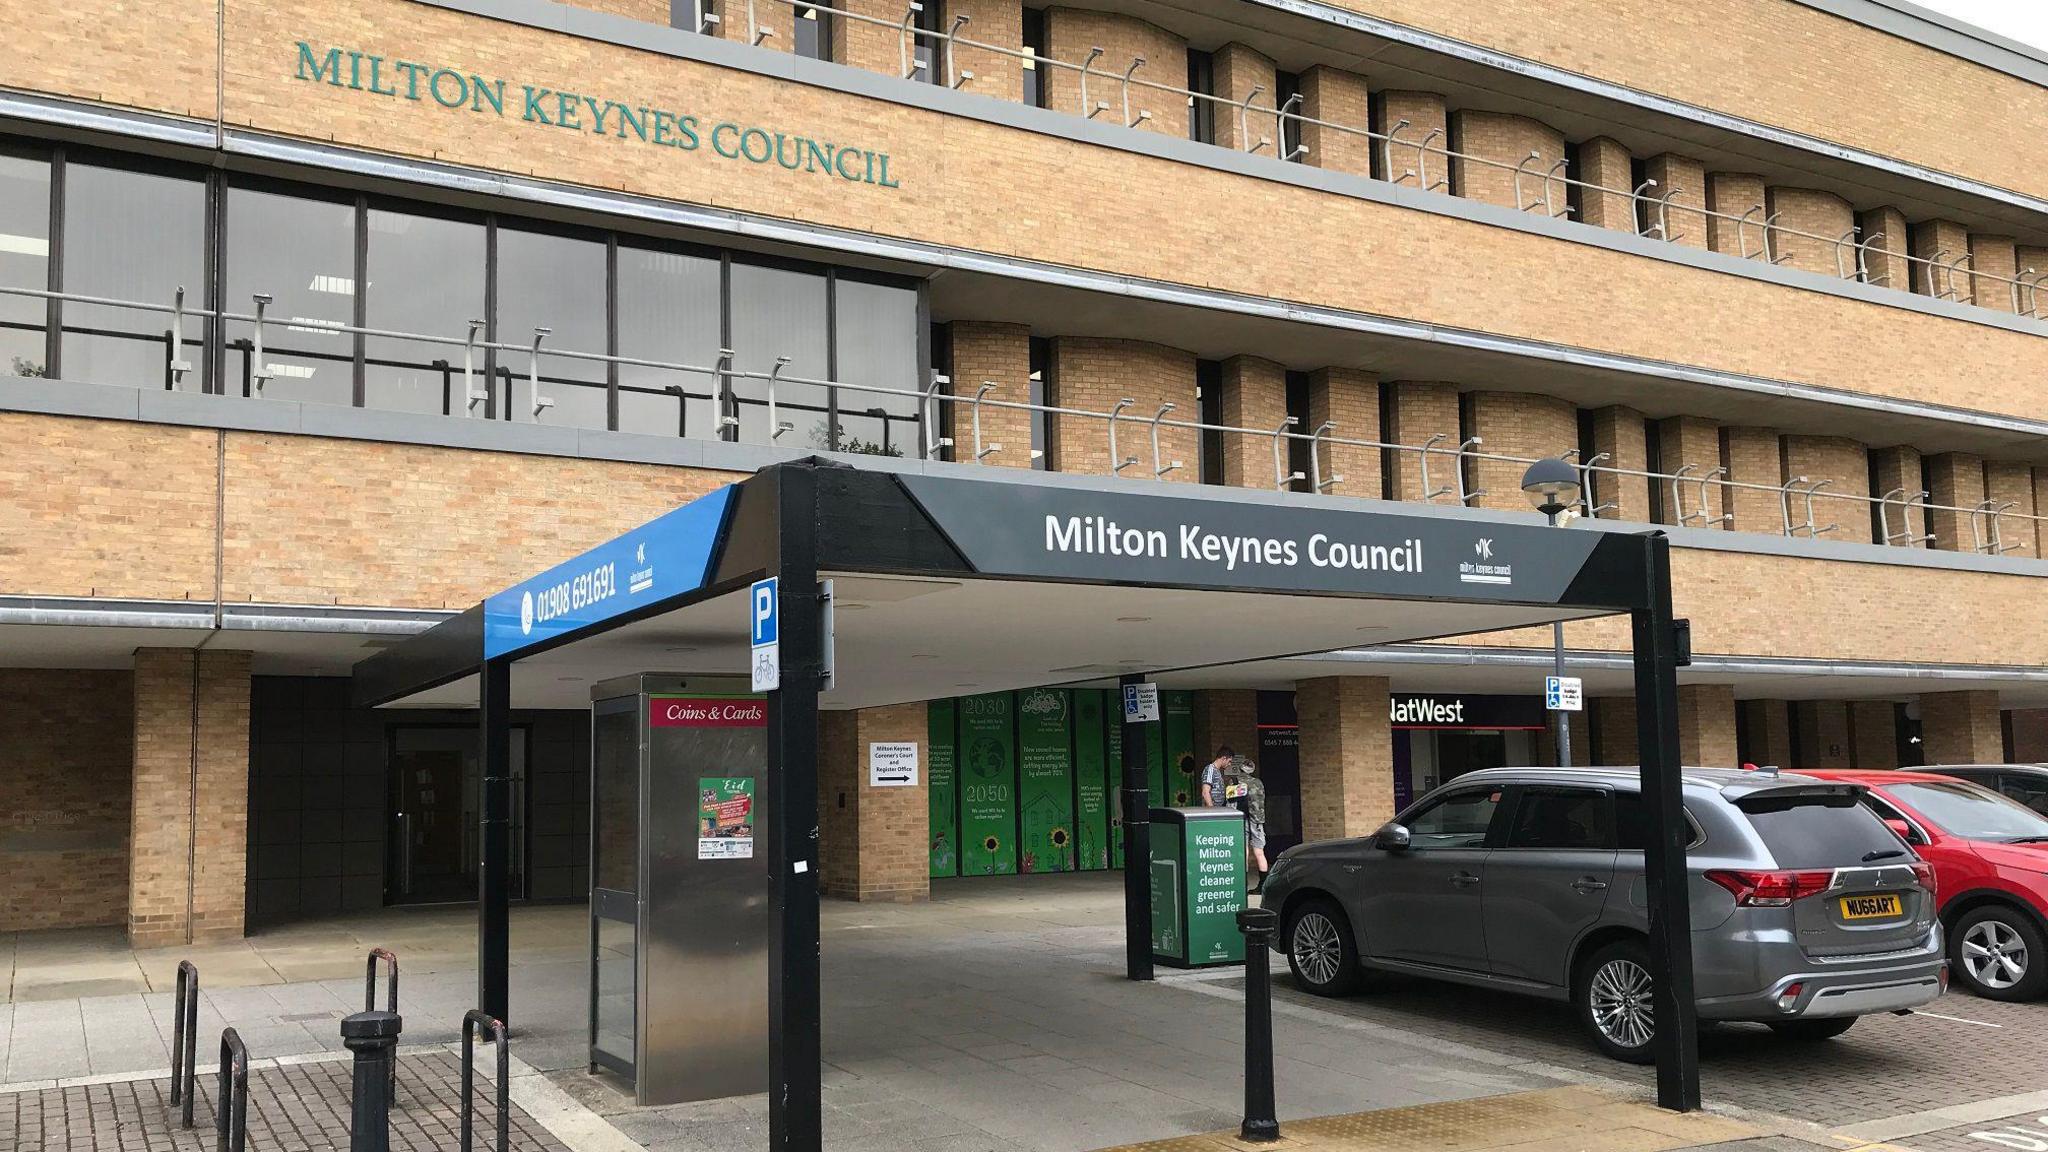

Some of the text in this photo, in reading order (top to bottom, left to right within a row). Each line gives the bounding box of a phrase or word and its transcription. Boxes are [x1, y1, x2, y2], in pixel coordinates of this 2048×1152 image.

[295, 41, 899, 188] MILTON KEYNES COUNCIL
[1045, 515, 1423, 573] Milton Keynes Council
[537, 582, 570, 623] 01908
[572, 561, 616, 611] 691691
[756, 586, 772, 640] P
[1127, 687, 1135, 699] P
[666, 704, 762, 720] Coins & Cards
[966, 698, 1005, 714] 2030
[724, 779, 746, 790] Eid
[967, 784, 1007, 802] 2050
[1196, 833, 1235, 847] Keeping
[1199, 847, 1231, 859] Milton
[1200, 861, 1234, 874] Keynes
[1200, 875, 1235, 886] cleaner
[1198, 890, 1235, 903] greener
[1196, 901, 1241, 914] and safer
